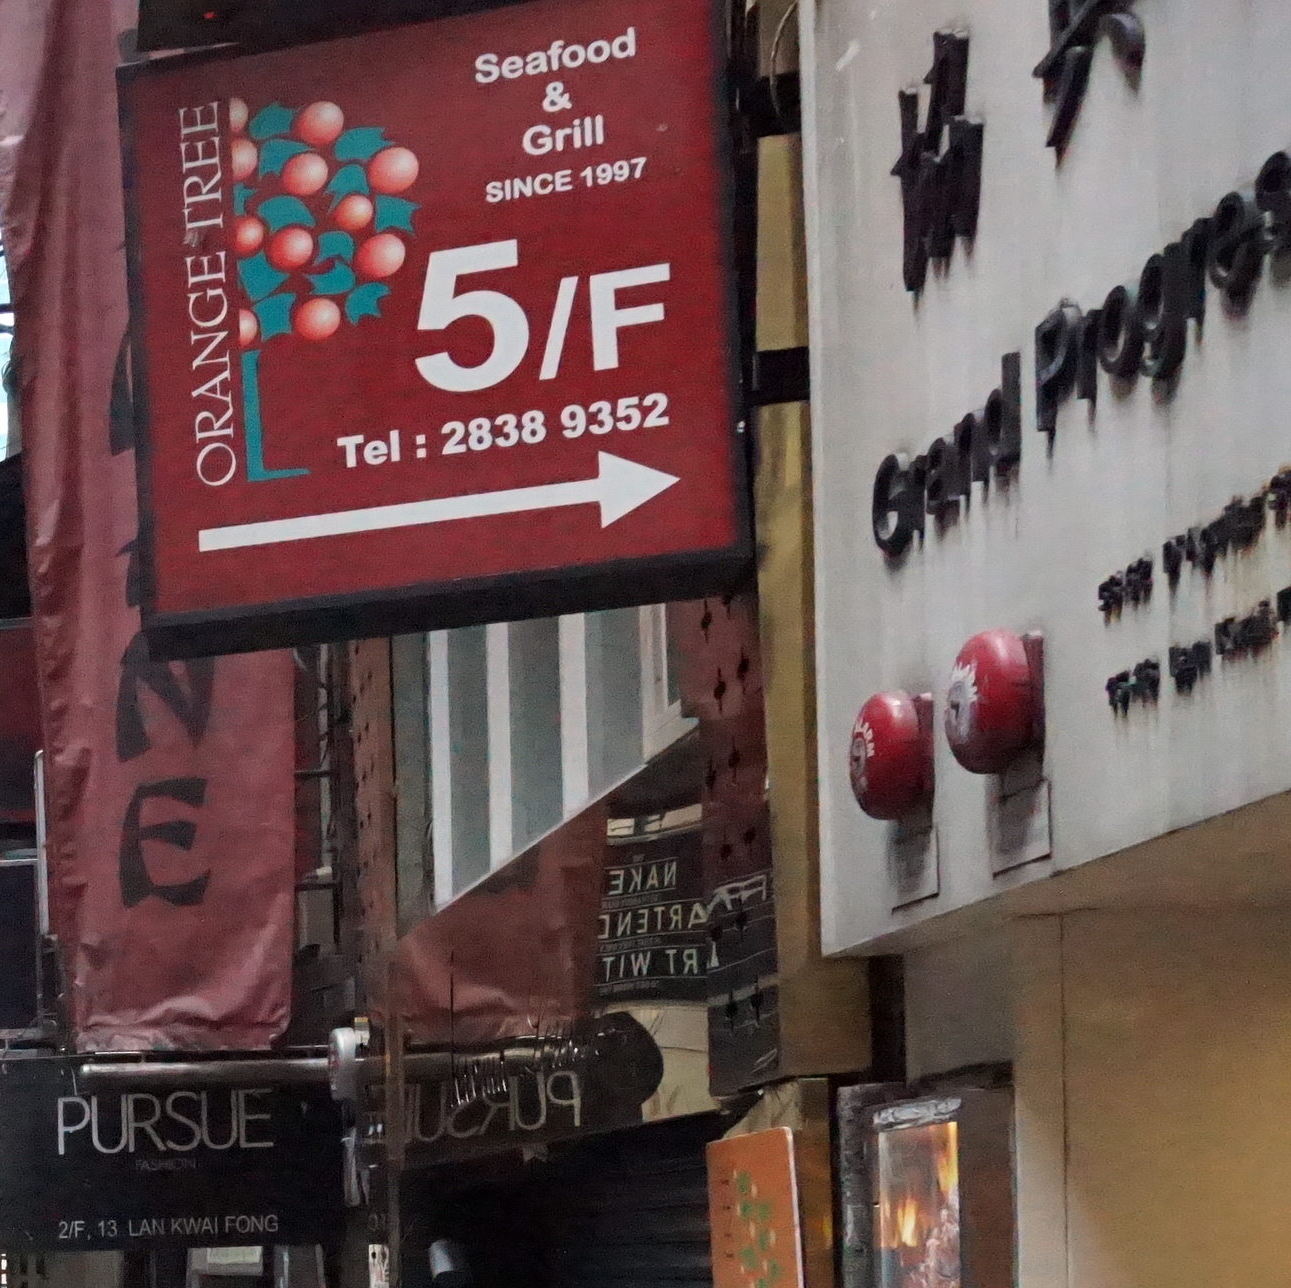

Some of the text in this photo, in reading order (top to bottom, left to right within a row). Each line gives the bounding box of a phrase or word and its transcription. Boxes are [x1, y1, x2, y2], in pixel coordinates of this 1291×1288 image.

[475, 27, 637, 84] Seafood
[543, 82, 572, 112] &
[523, 116, 605, 156] Grill
[485, 158, 646, 203] SINCE 1997
[178, 99, 237, 487] ORANGE TREE
[414, 238, 671, 393] 5/F
[337, 429, 400, 470] Tel
[442, 410, 547, 456] 2838
[561, 393, 670, 439] 9352
[872, 352, 1022, 557] Grand
[57, 1089, 274, 1155] PURSUE
[98, 1219, 118, 1238] 13
[128, 1217, 166, 1237] LAN
[171, 1215, 219, 1236] KWAI
[225, 1214, 279, 1234] FONG
